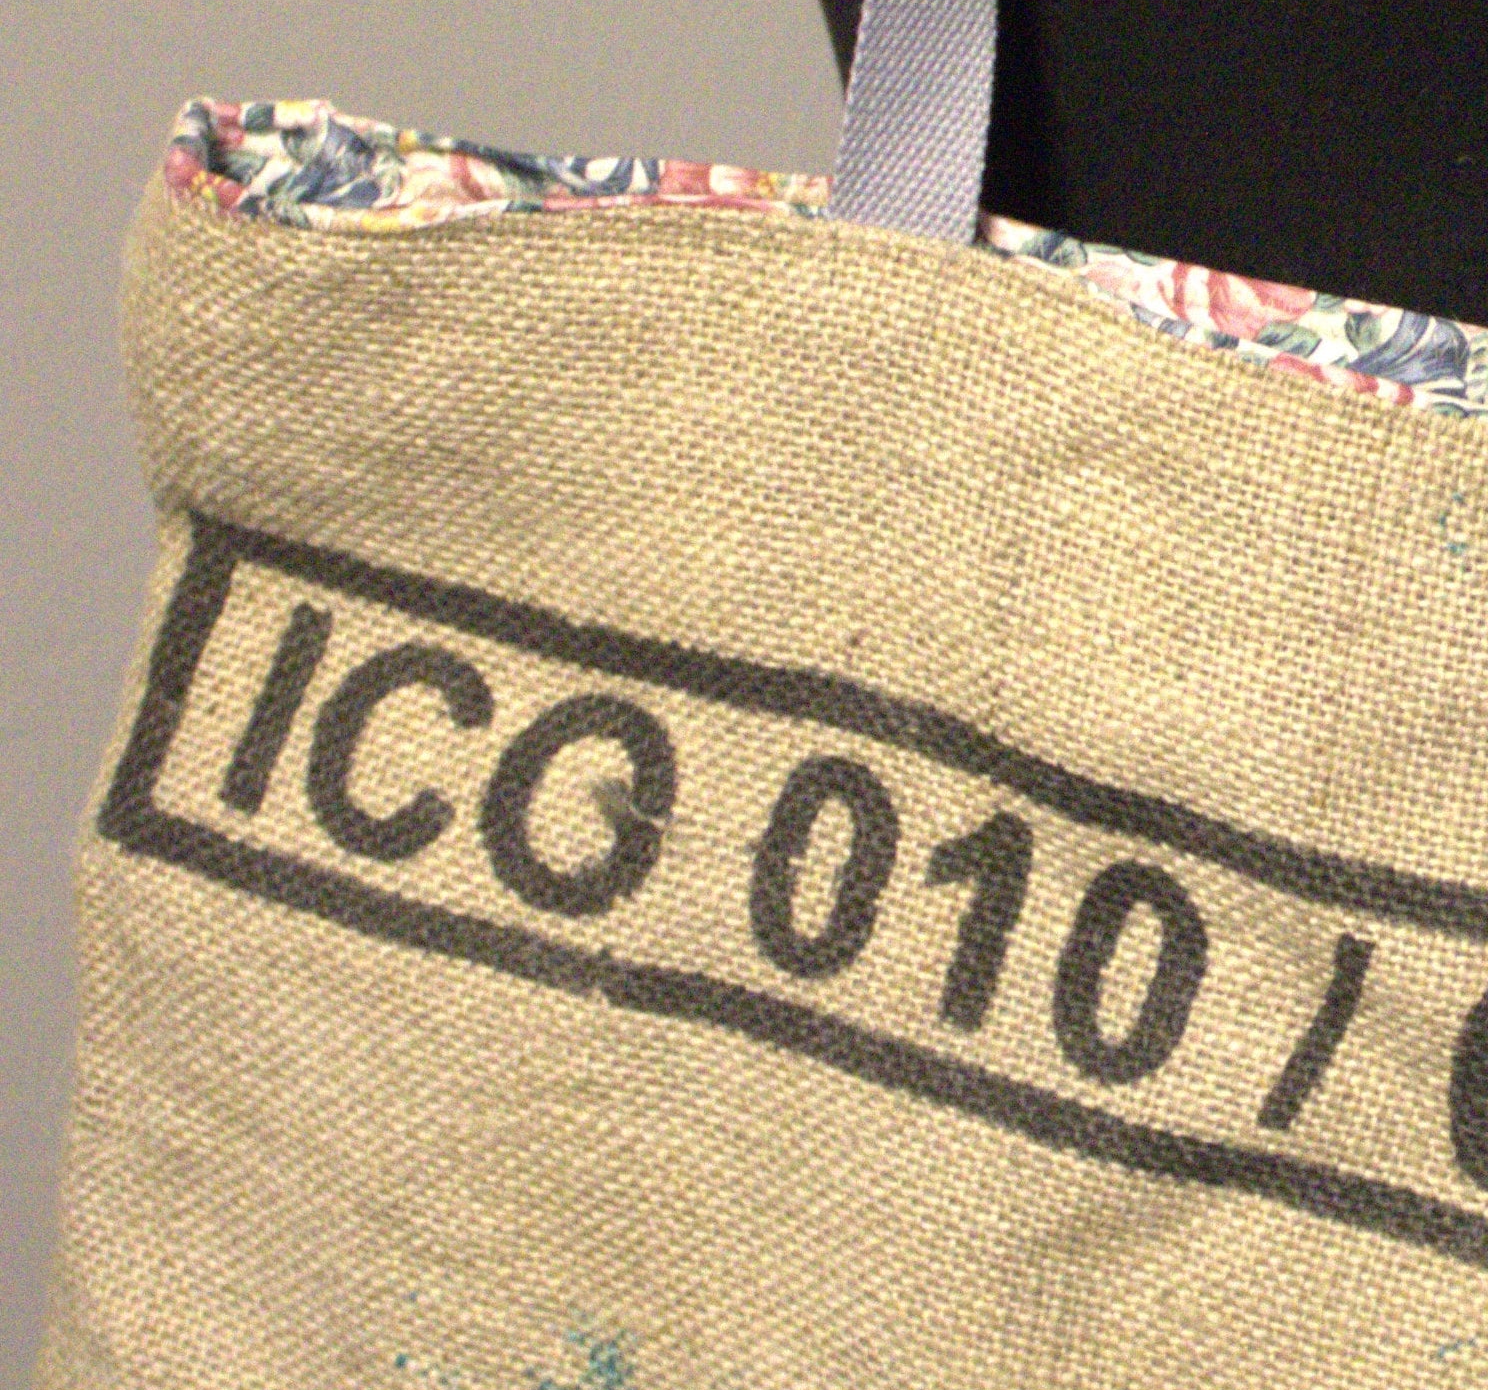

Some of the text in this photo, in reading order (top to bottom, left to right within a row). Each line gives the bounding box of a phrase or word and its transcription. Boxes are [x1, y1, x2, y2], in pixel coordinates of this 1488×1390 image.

[219, 603, 677, 917] ICO
[748, 755, 1208, 1086] 010
[1257, 932, 1377, 1132] /
